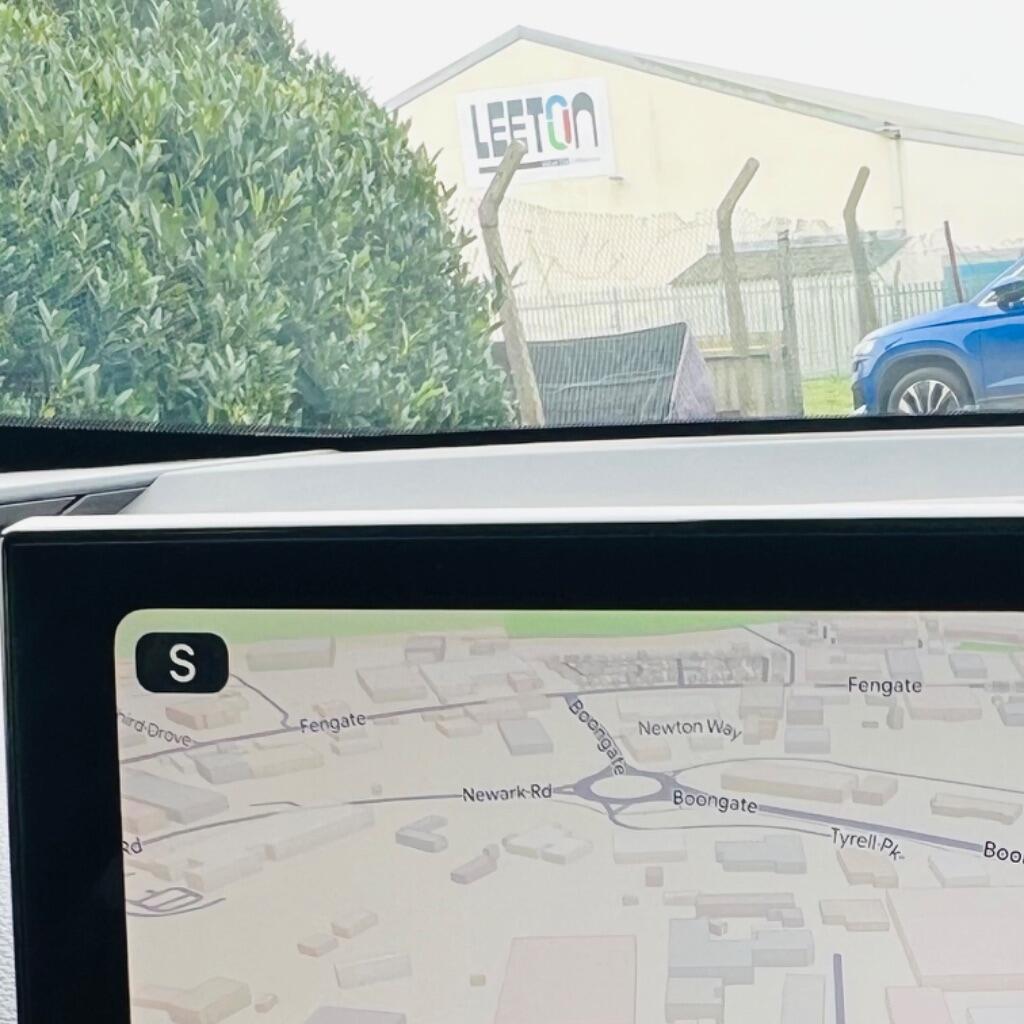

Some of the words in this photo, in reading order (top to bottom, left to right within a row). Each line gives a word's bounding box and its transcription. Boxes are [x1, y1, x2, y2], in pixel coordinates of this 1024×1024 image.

[168, 643, 197, 684] S
[848, 676, 922, 697] Fengate
[147, 722, 192, 747] Drove
[300, 712, 367, 734] Fengate
[638, 720, 703, 736] Newton
[707, 719, 742, 742] Way
[568, 699, 625, 776] Boongate
[462, 785, 526, 802] Newark
[530, 783, 552, 799] Rd
[673, 789, 758, 814] Boongate
[831, 827, 877, 850] Tyrell
